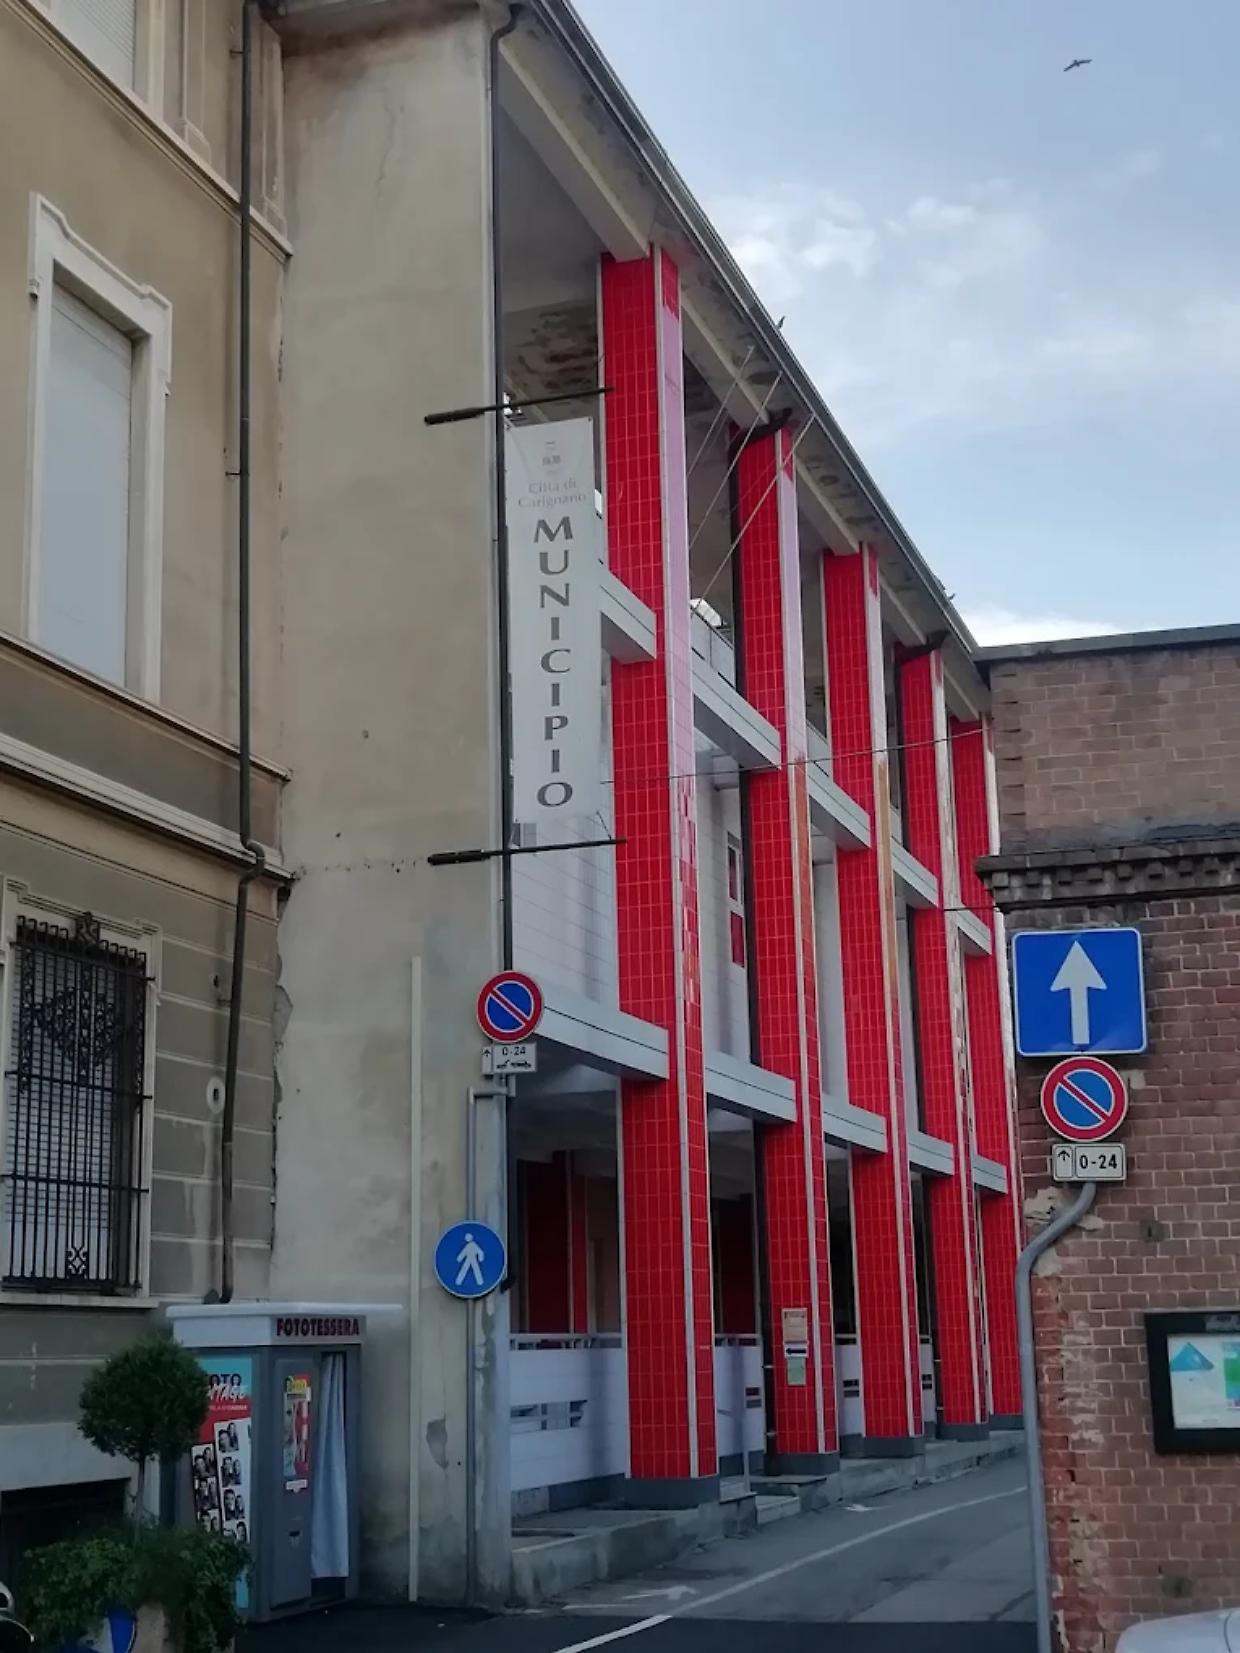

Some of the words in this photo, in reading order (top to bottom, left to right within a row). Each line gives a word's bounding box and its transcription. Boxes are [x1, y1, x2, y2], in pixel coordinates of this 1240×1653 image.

[563, 476, 577, 490] di
[518, 494, 587, 511] Carignano
[534, 516, 574, 807] MUNICIPIO
[1080, 1154, 1118, 1169] 0-24
[277, 1318, 359, 1336] FOTOTESSERA
[207, 1373, 242, 1388] OTO
